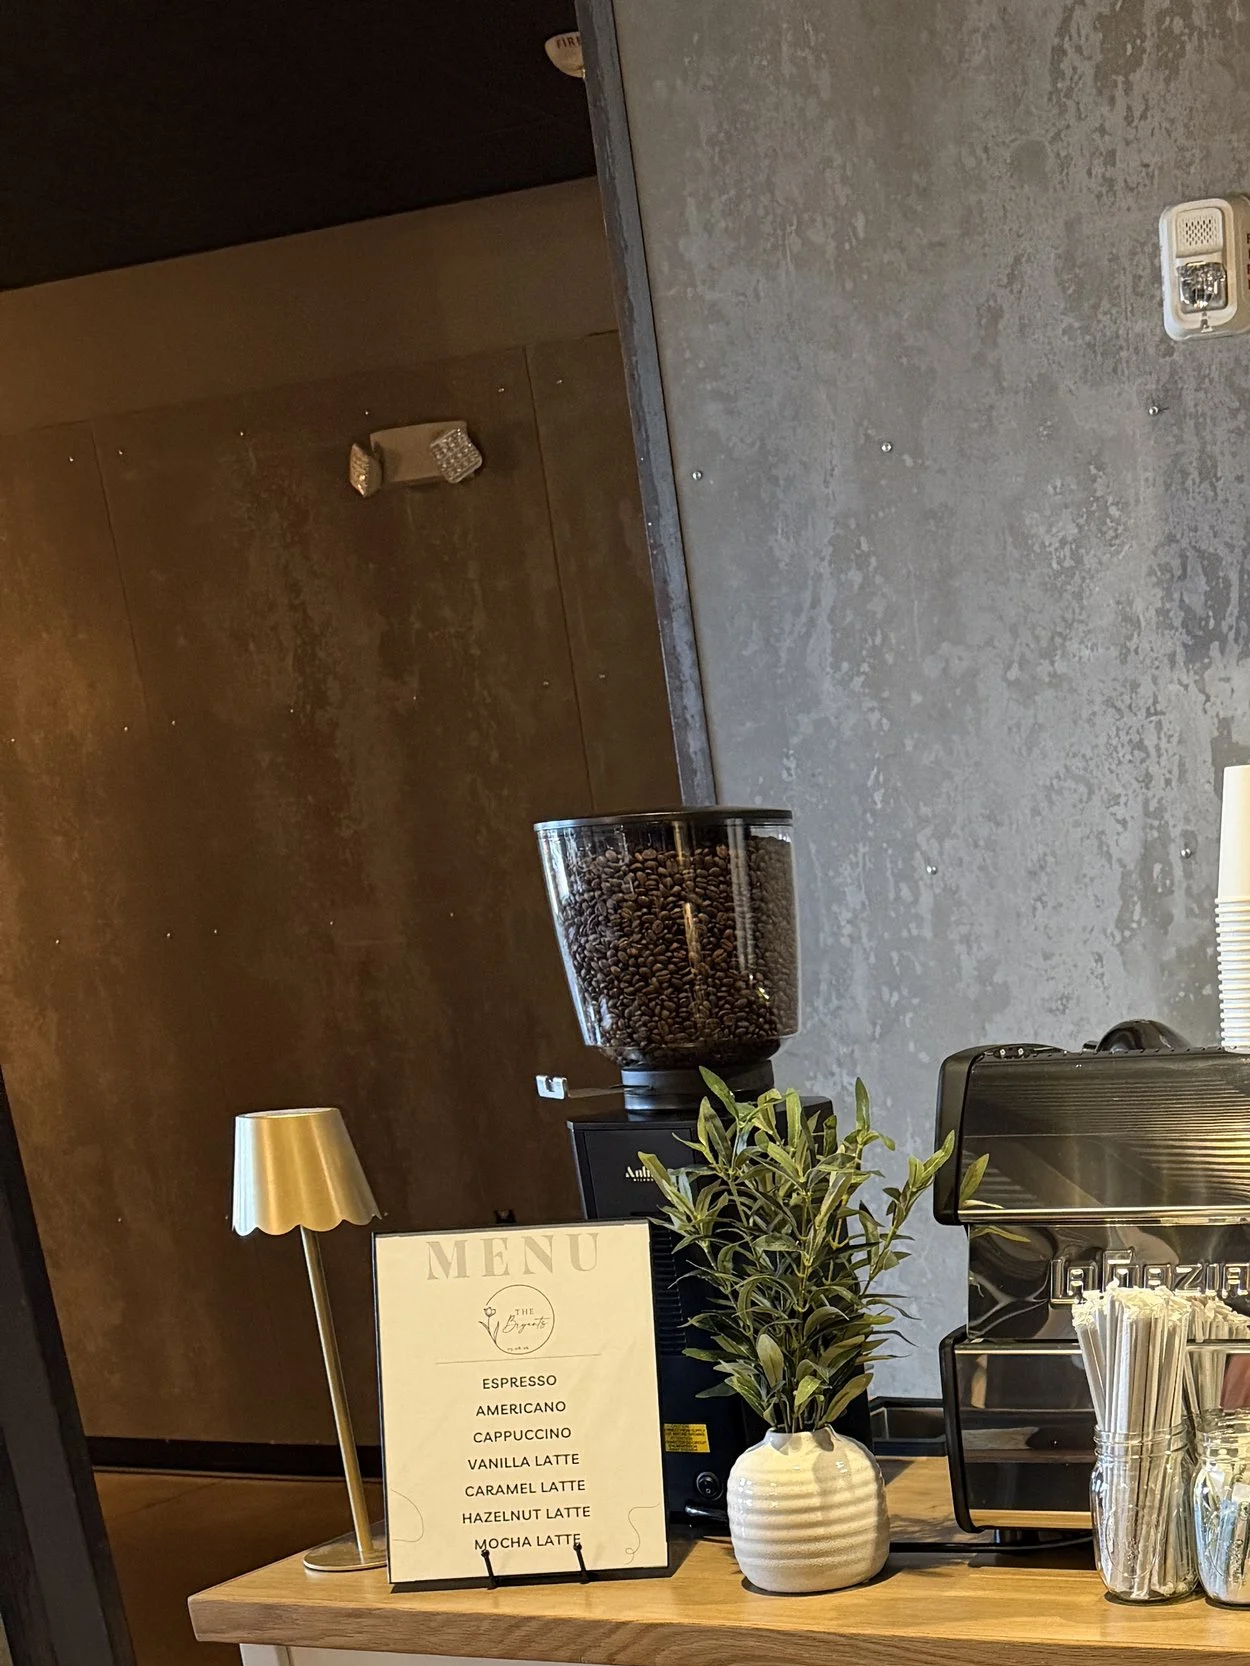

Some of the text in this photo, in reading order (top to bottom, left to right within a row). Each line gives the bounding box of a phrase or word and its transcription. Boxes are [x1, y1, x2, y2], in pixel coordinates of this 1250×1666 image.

[426, 1233, 599, 1281] MENU
[515, 1308, 535, 1317] THE
[482, 1374, 557, 1390] ESPRESSO
[475, 1400, 567, 1417] AMERICANO
[473, 1427, 572, 1443] CAPPUCCINO
[467, 1453, 580, 1471] VANILLA LATTE
[464, 1479, 586, 1498] CARAMEL LATTE
[462, 1505, 591, 1524] HAZELNUT LATTE
[474, 1533, 581, 1550] MOCHA LATTE
